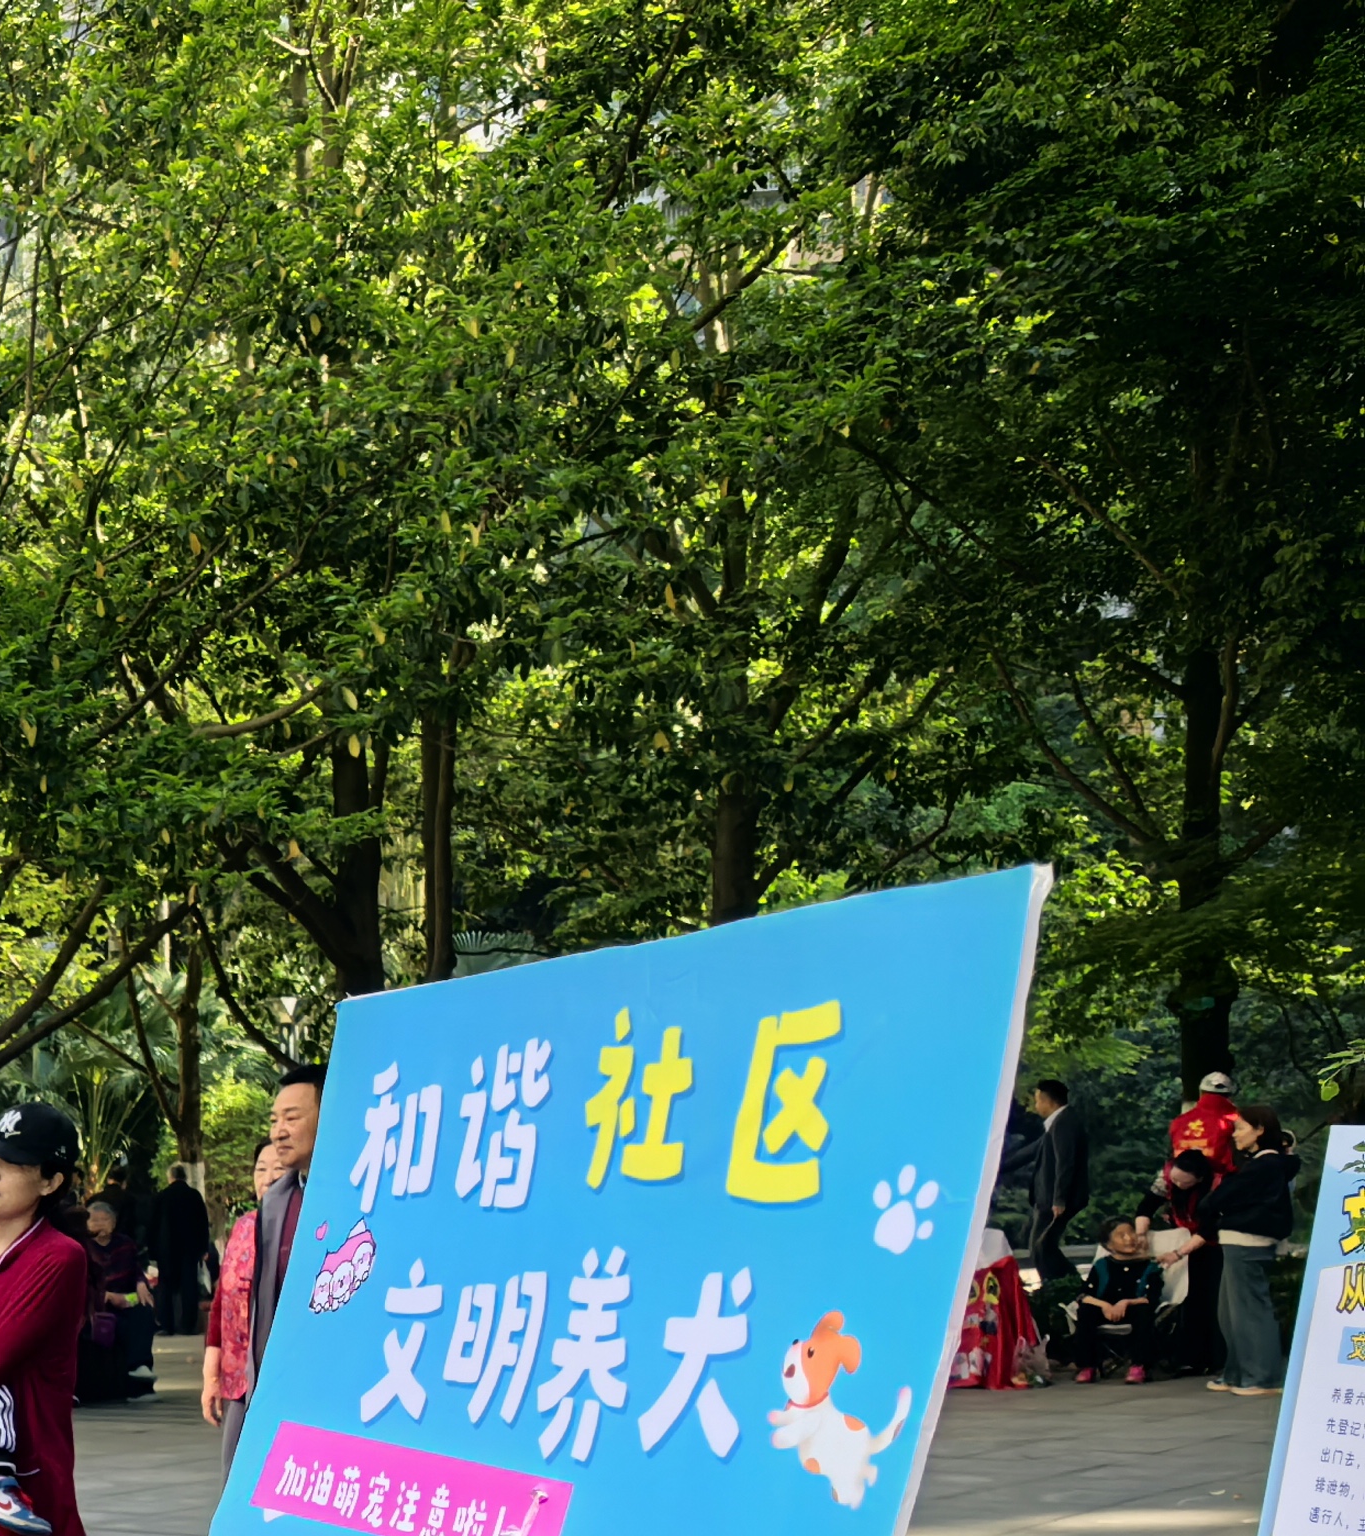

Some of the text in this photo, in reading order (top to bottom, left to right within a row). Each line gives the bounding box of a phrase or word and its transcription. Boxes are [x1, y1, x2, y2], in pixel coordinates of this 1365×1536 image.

[350, 999, 843, 1213] 和谐社区
[360, 1245, 754, 1463] 文明养犬
